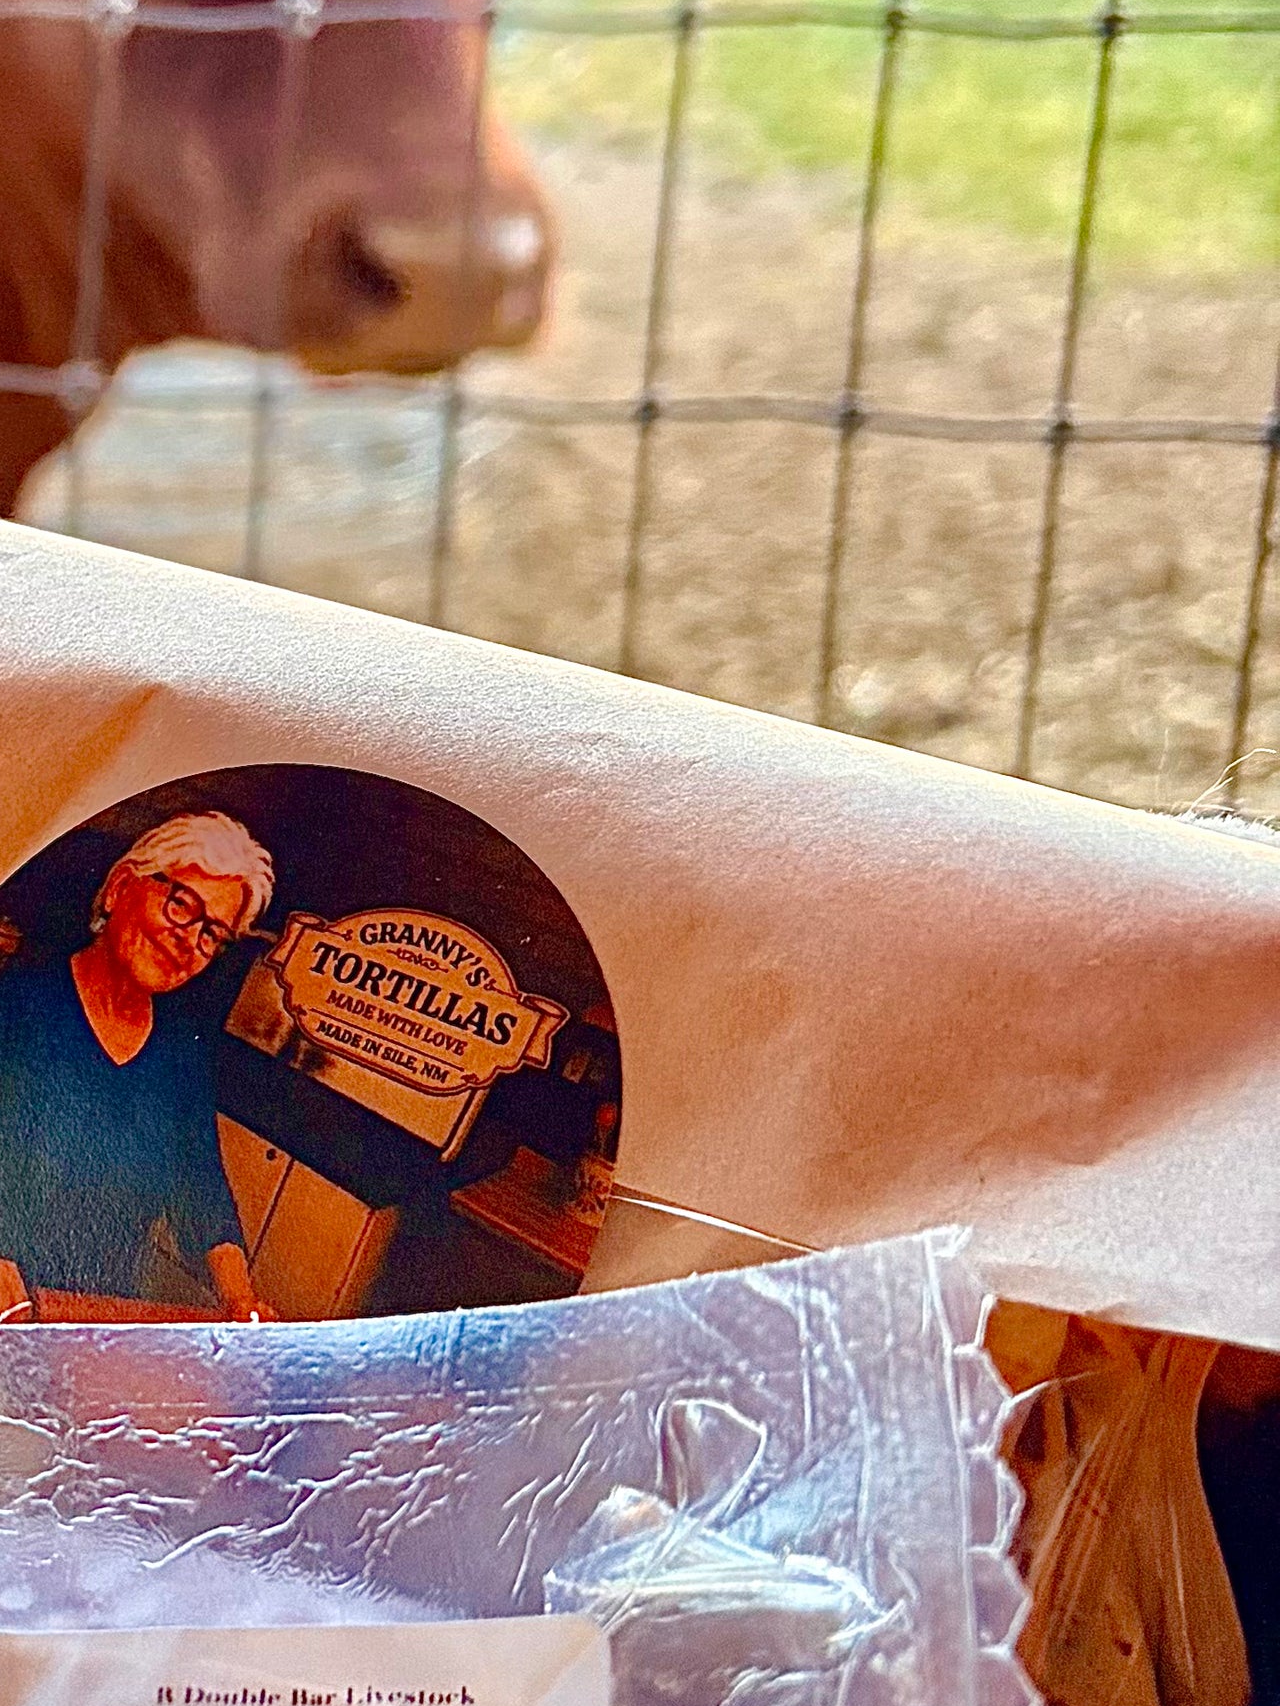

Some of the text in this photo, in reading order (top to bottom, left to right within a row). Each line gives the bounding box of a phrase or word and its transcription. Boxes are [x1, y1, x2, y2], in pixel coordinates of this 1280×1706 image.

[359, 922, 490, 987] GRANNY'S
[309, 941, 518, 1045] TORTILLAS
[326, 990, 468, 1056] MADE WITH LOVE
[316, 1020, 450, 1083] MADE IN SILE, NM
[184, 1686, 475, 1705] Double Bar Livestock
